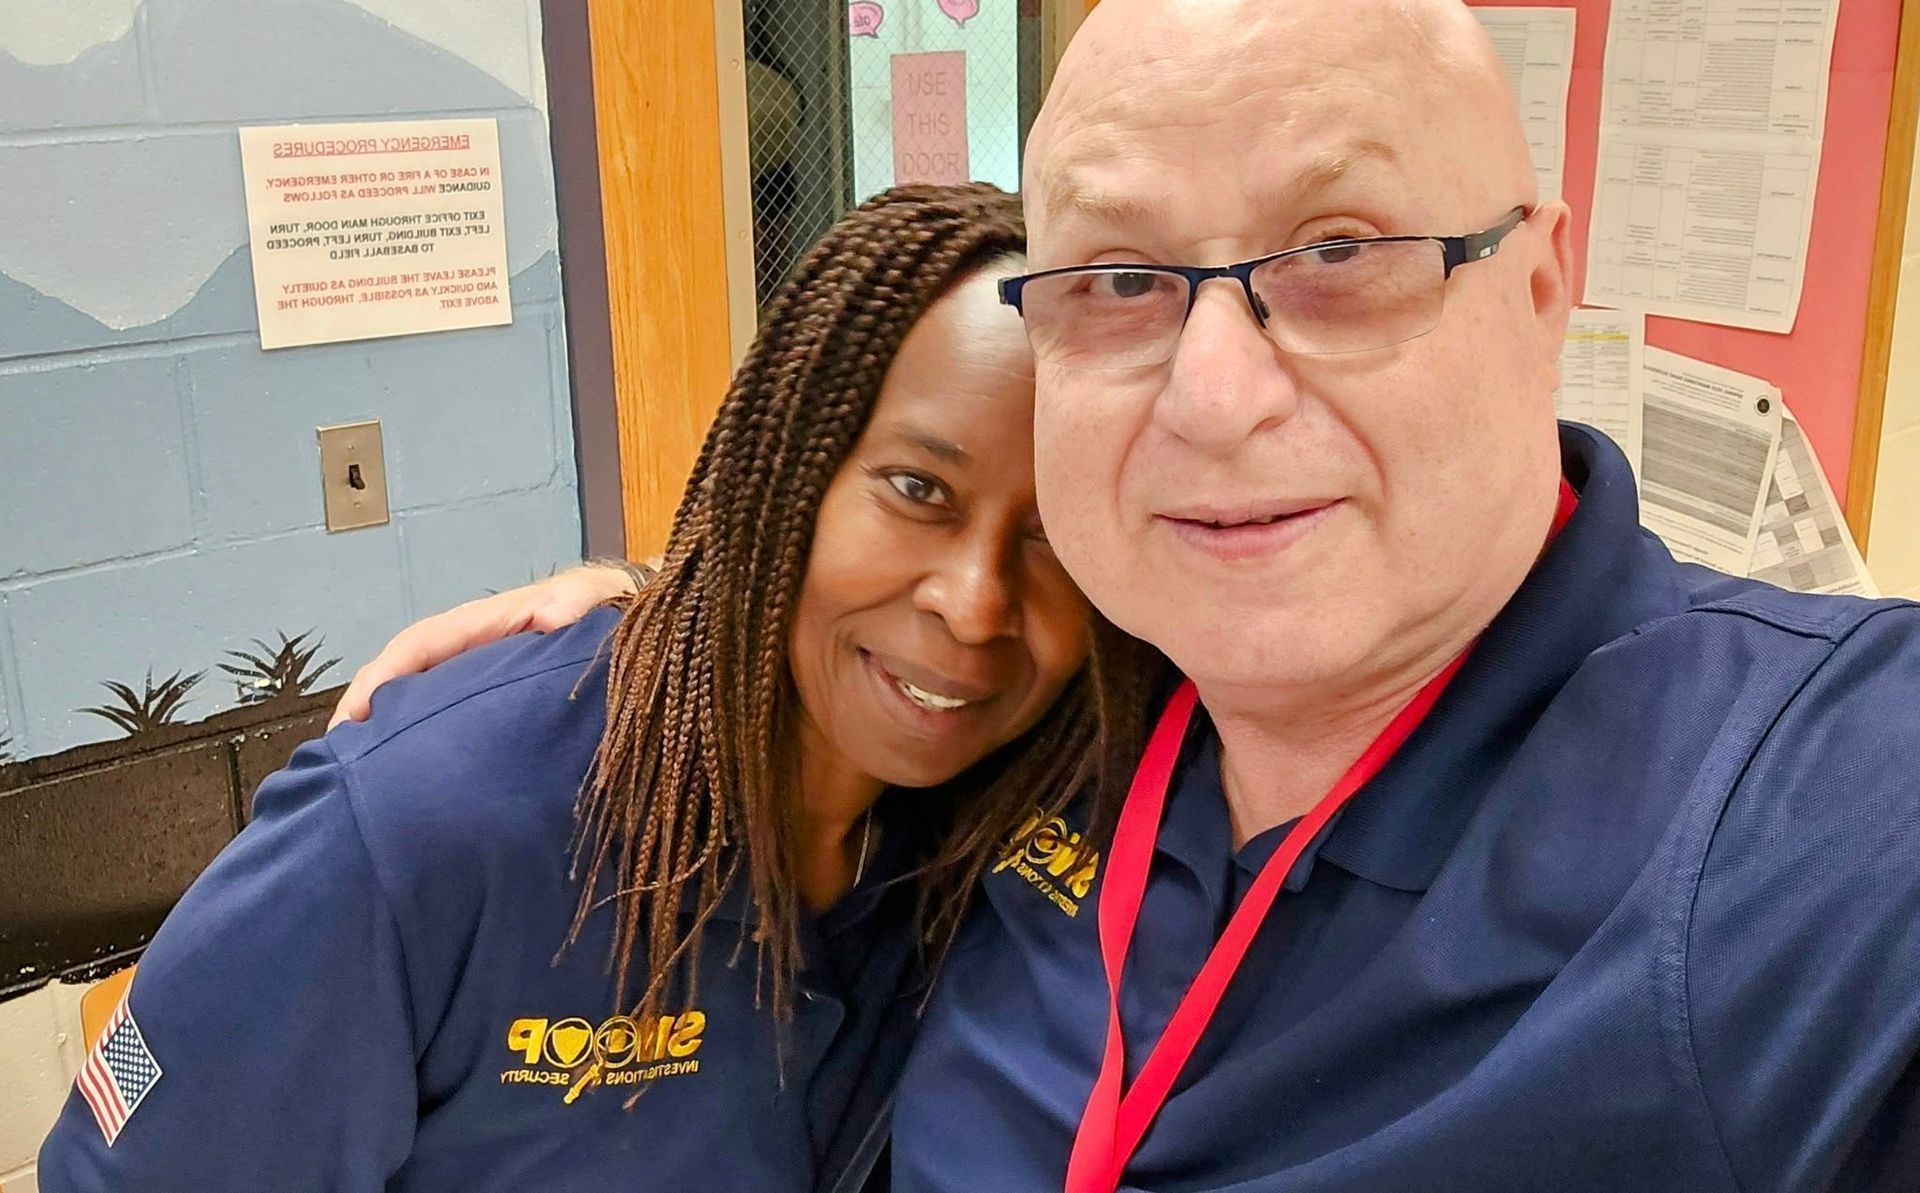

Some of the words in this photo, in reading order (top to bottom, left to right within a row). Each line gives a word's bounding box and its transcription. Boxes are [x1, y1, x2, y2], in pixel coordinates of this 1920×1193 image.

[908, 72, 946, 96] USE
[907, 113, 951, 137] THIS
[903, 153, 960, 176] DOOR
